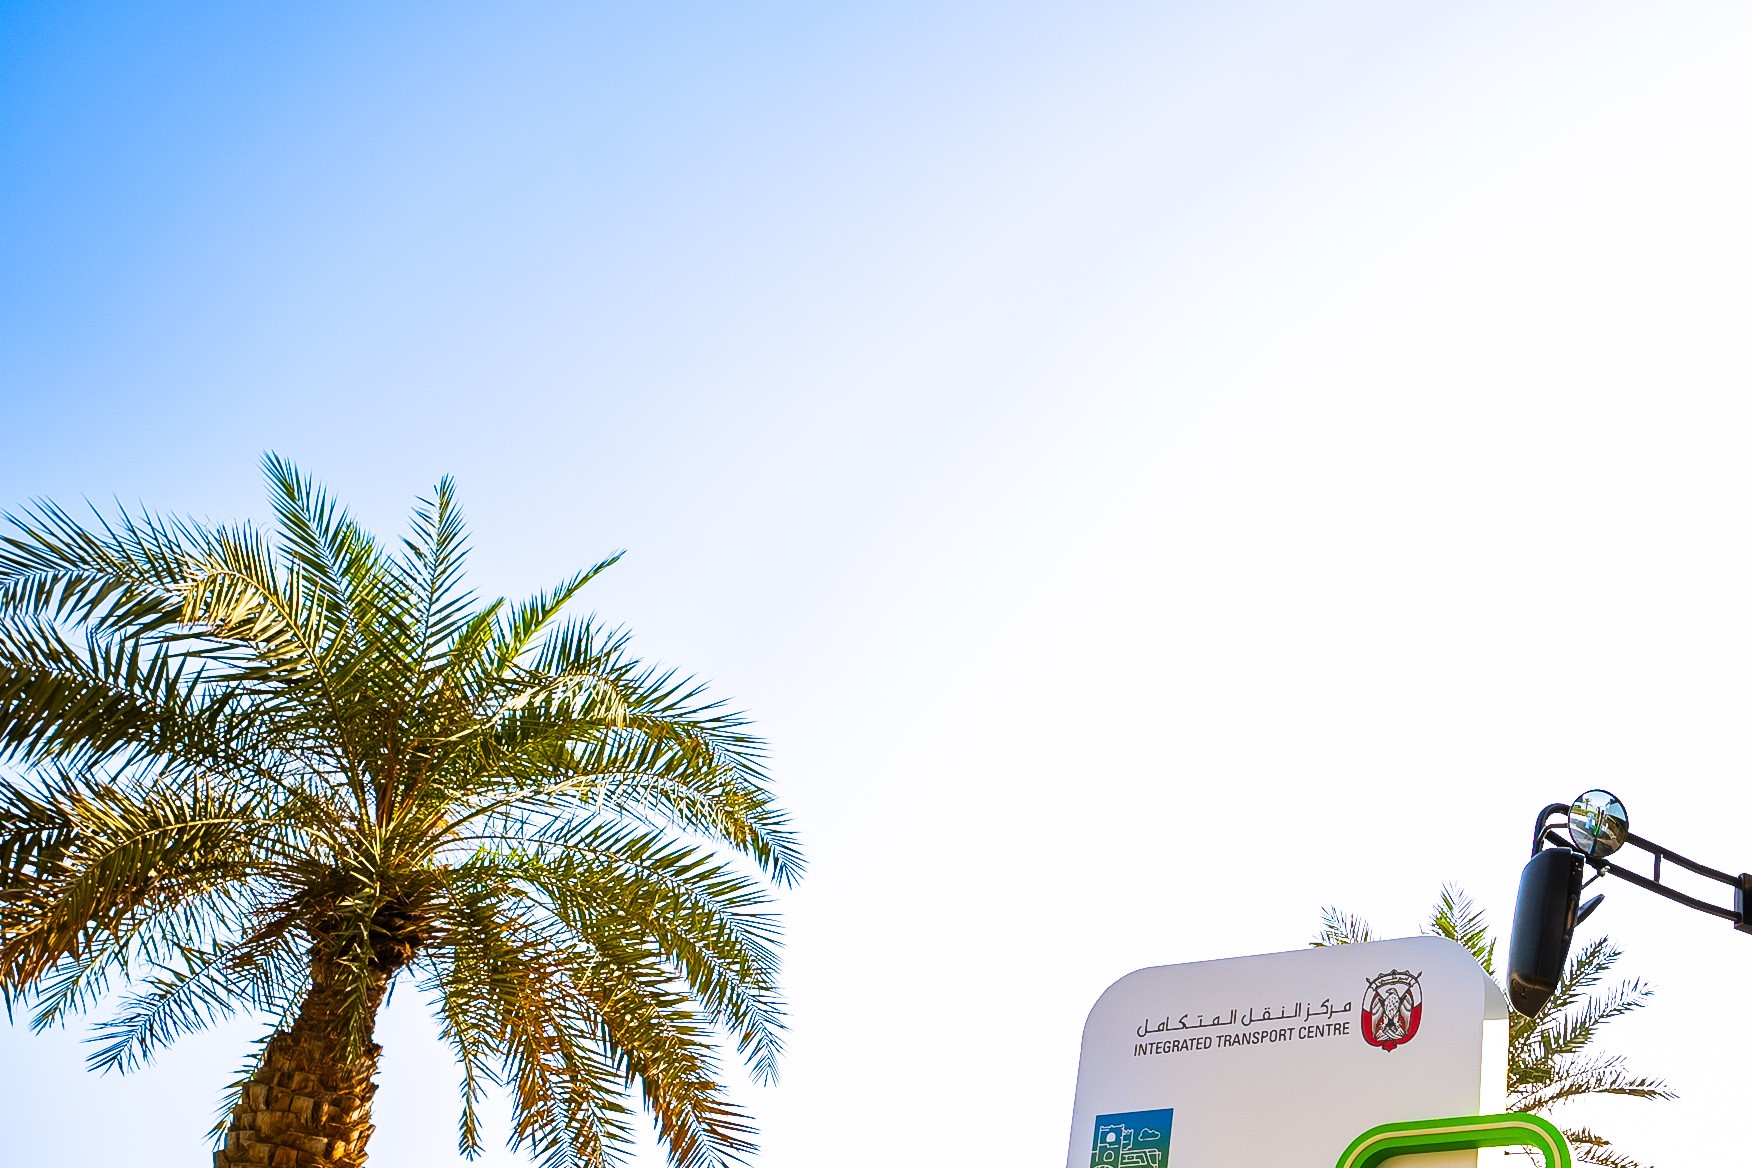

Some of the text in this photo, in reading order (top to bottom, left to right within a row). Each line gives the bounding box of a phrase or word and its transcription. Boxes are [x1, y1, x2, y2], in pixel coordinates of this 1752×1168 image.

[1137, 998, 1352, 1037] مركز النقل المتكامل
[1134, 1022, 1350, 1057] INTEGRATED TRANSPORT CENTRE
